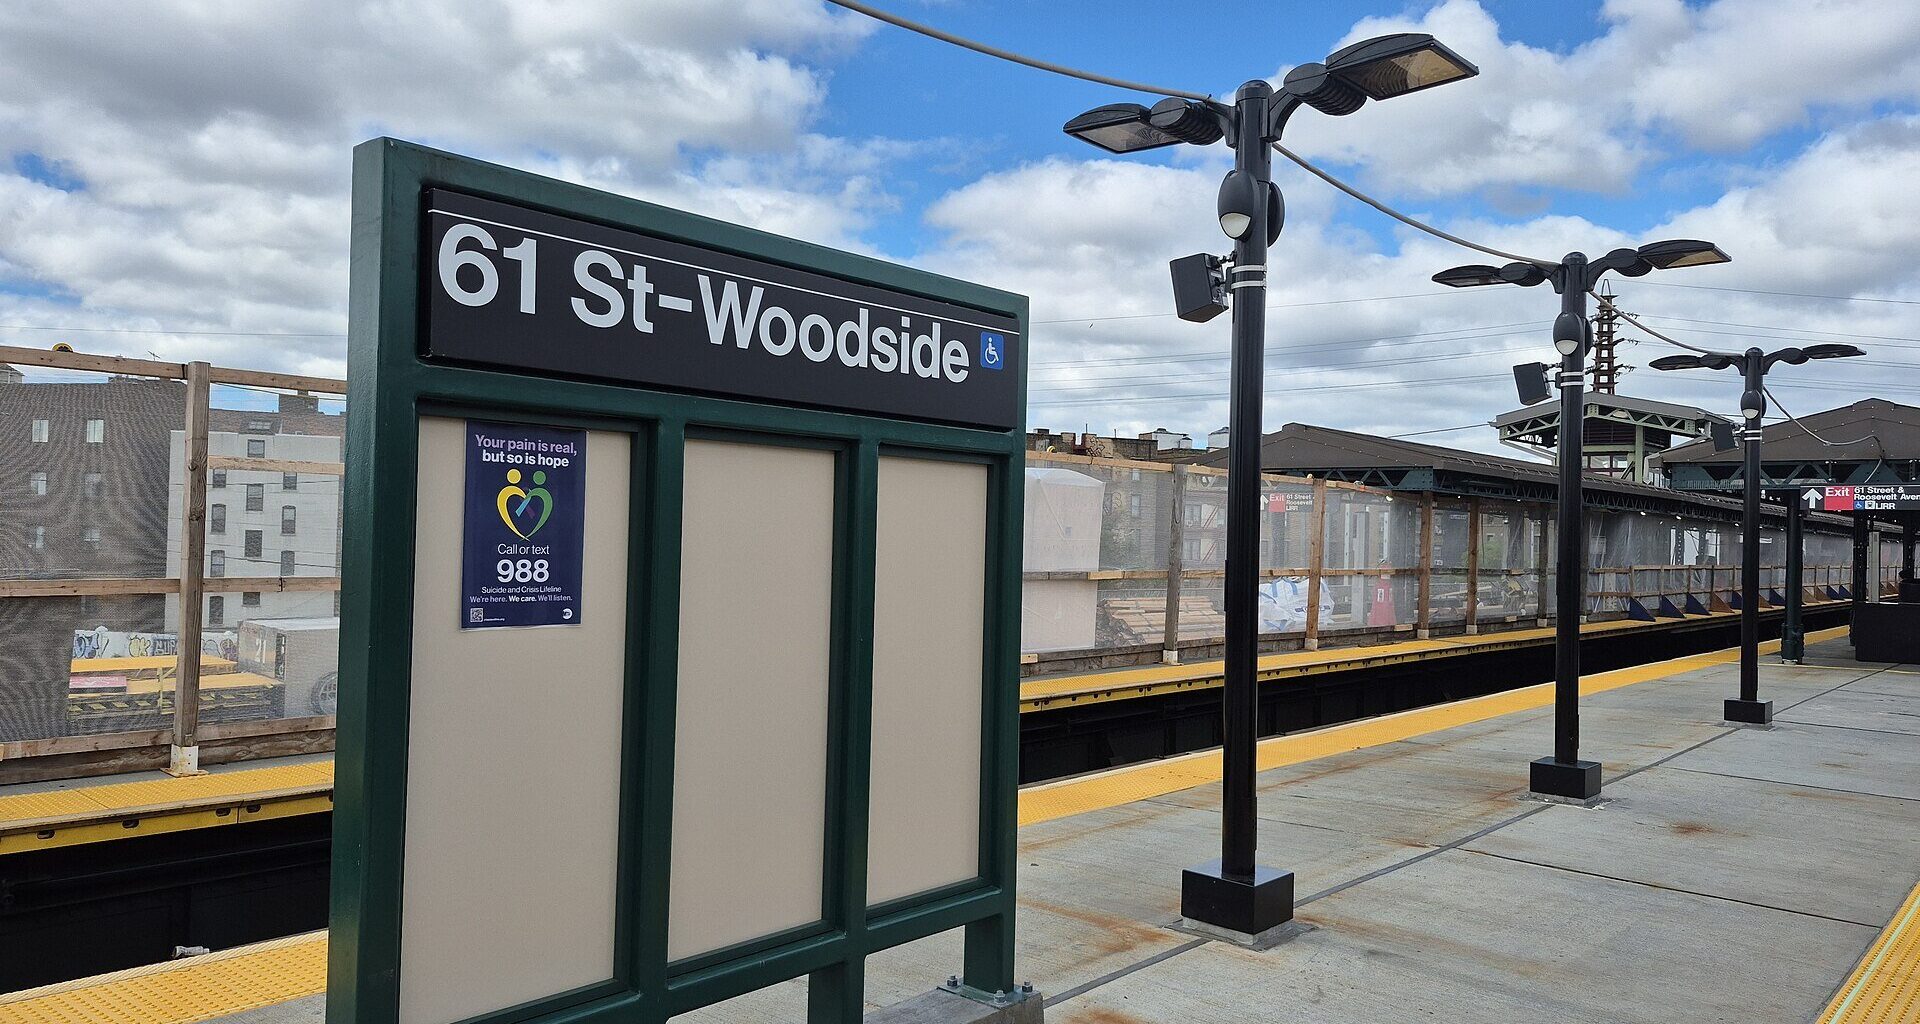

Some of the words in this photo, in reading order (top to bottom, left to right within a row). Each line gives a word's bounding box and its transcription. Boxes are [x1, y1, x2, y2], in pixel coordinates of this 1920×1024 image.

[438, 223, 537, 314] 61
[571, 250, 970, 383] St-Woodside
[475, 434, 506, 448] Your
[507, 438, 536, 452] pain
[538, 439, 549, 452] is
[550, 442, 577, 456] real,
[482, 449, 505, 463] but
[506, 453, 523, 464] so
[525, 452, 536, 465] is
[537, 453, 570, 469] hope
[1269, 493, 1284, 501] Exit
[1825, 487, 1850, 496] Exit
[497, 543, 518, 555] Call
[519, 545, 530, 555] or
[531, 544, 550, 555] text
[496, 559, 549, 583] 988
[481, 586, 507, 594] Suicide
[521, 585, 539, 593] Crisis
[539, 585, 562, 593] Lifeline
[489, 595, 508, 603] here.
[537, 594, 553, 602] We'll
